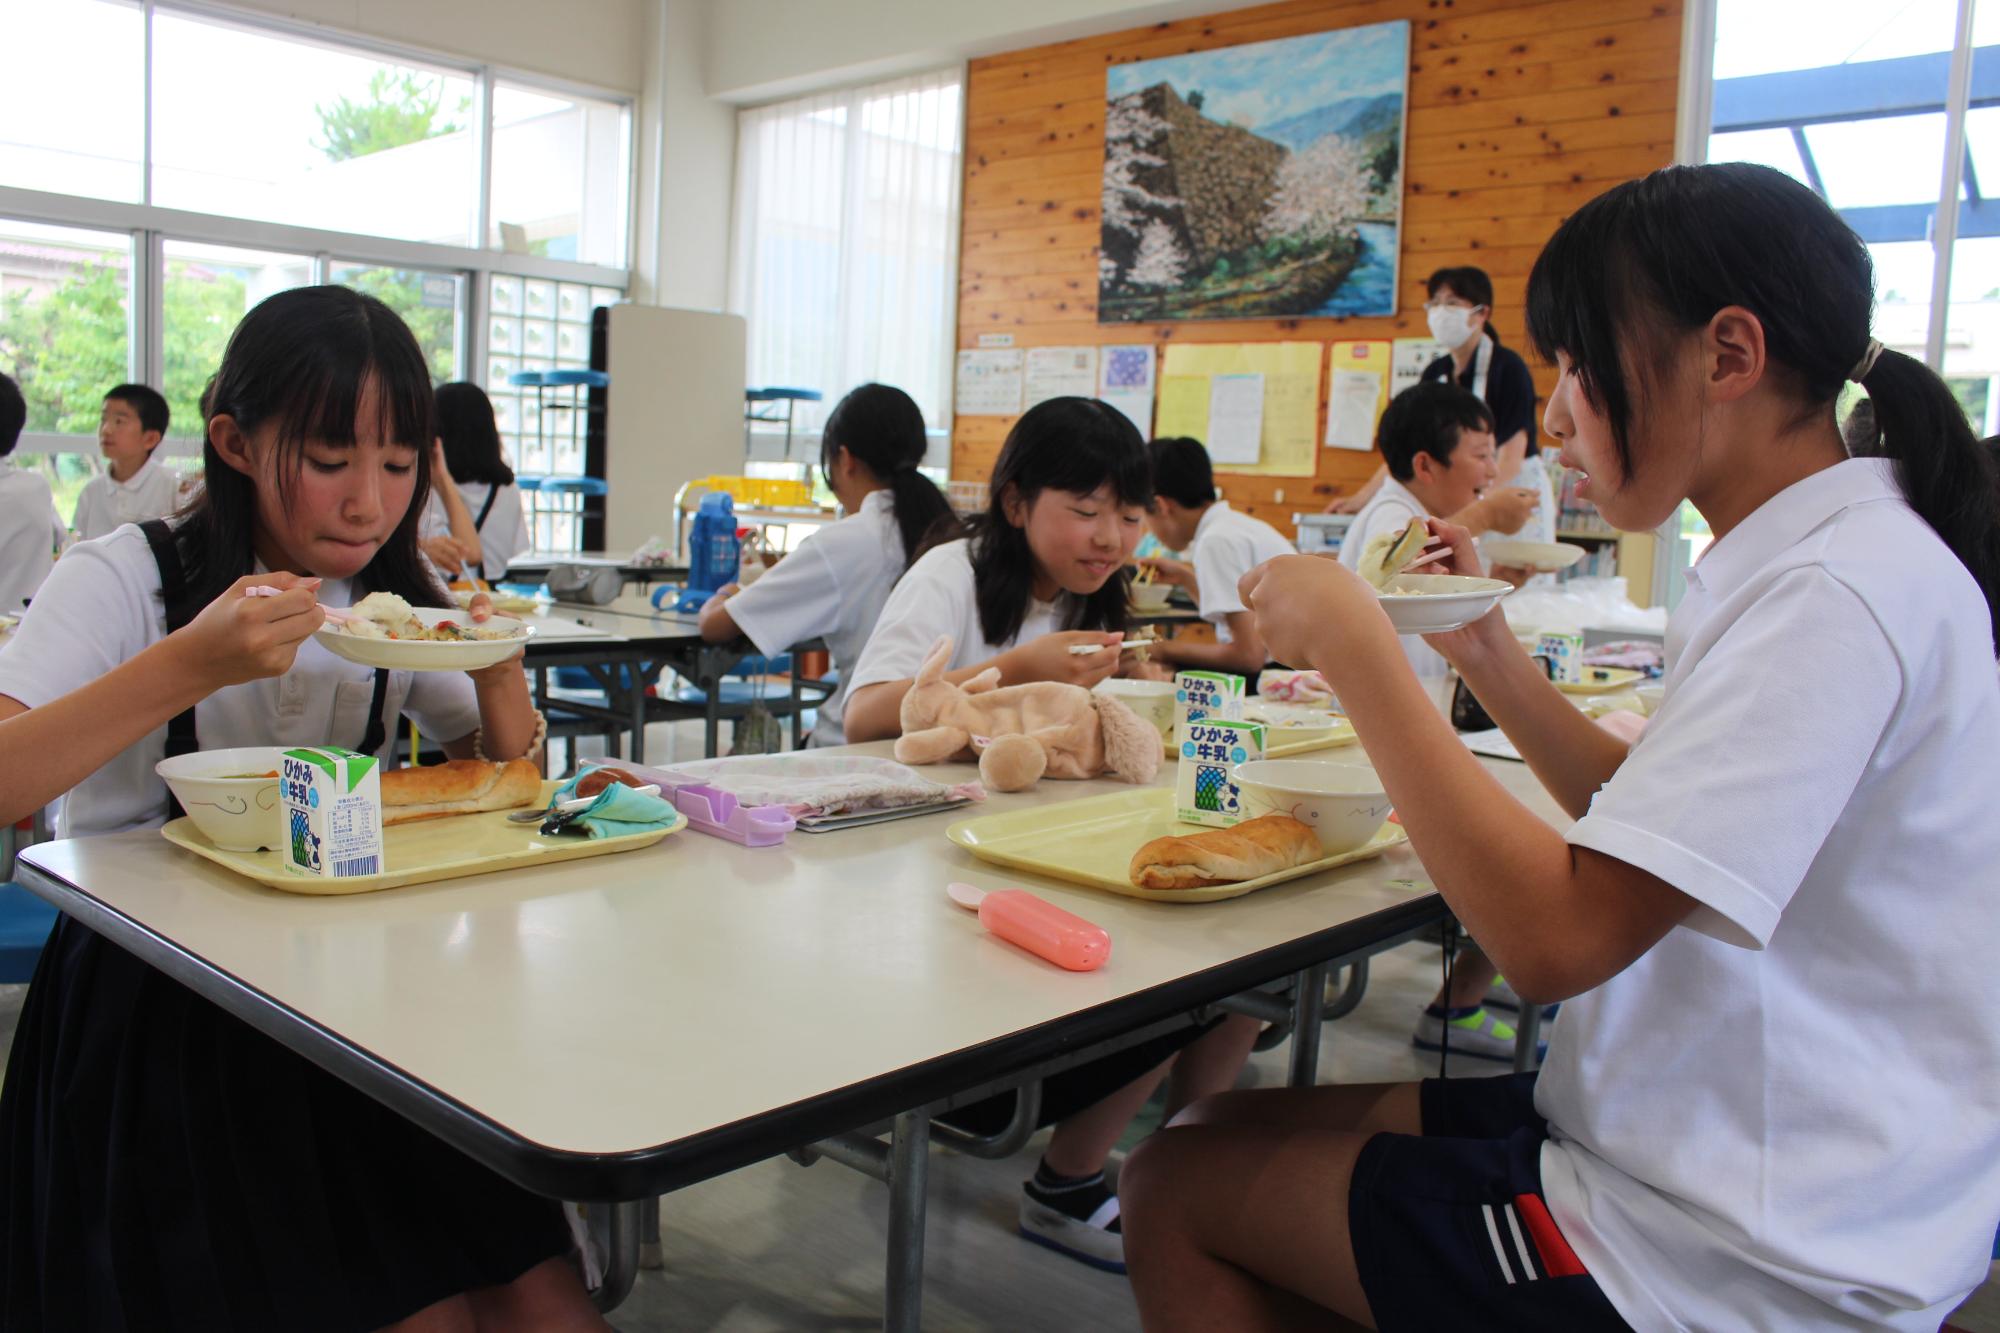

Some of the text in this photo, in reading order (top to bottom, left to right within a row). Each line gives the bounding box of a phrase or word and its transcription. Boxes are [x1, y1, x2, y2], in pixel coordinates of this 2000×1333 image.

[1183, 678, 1216, 693] ひかみ
[1187, 691, 1210, 706] 牛乳
[1190, 726, 1239, 746] ひかみ
[1197, 743, 1229, 762] 牛乳
[284, 759, 313, 785] ひかみ
[289, 781, 309, 806] 牛乳
